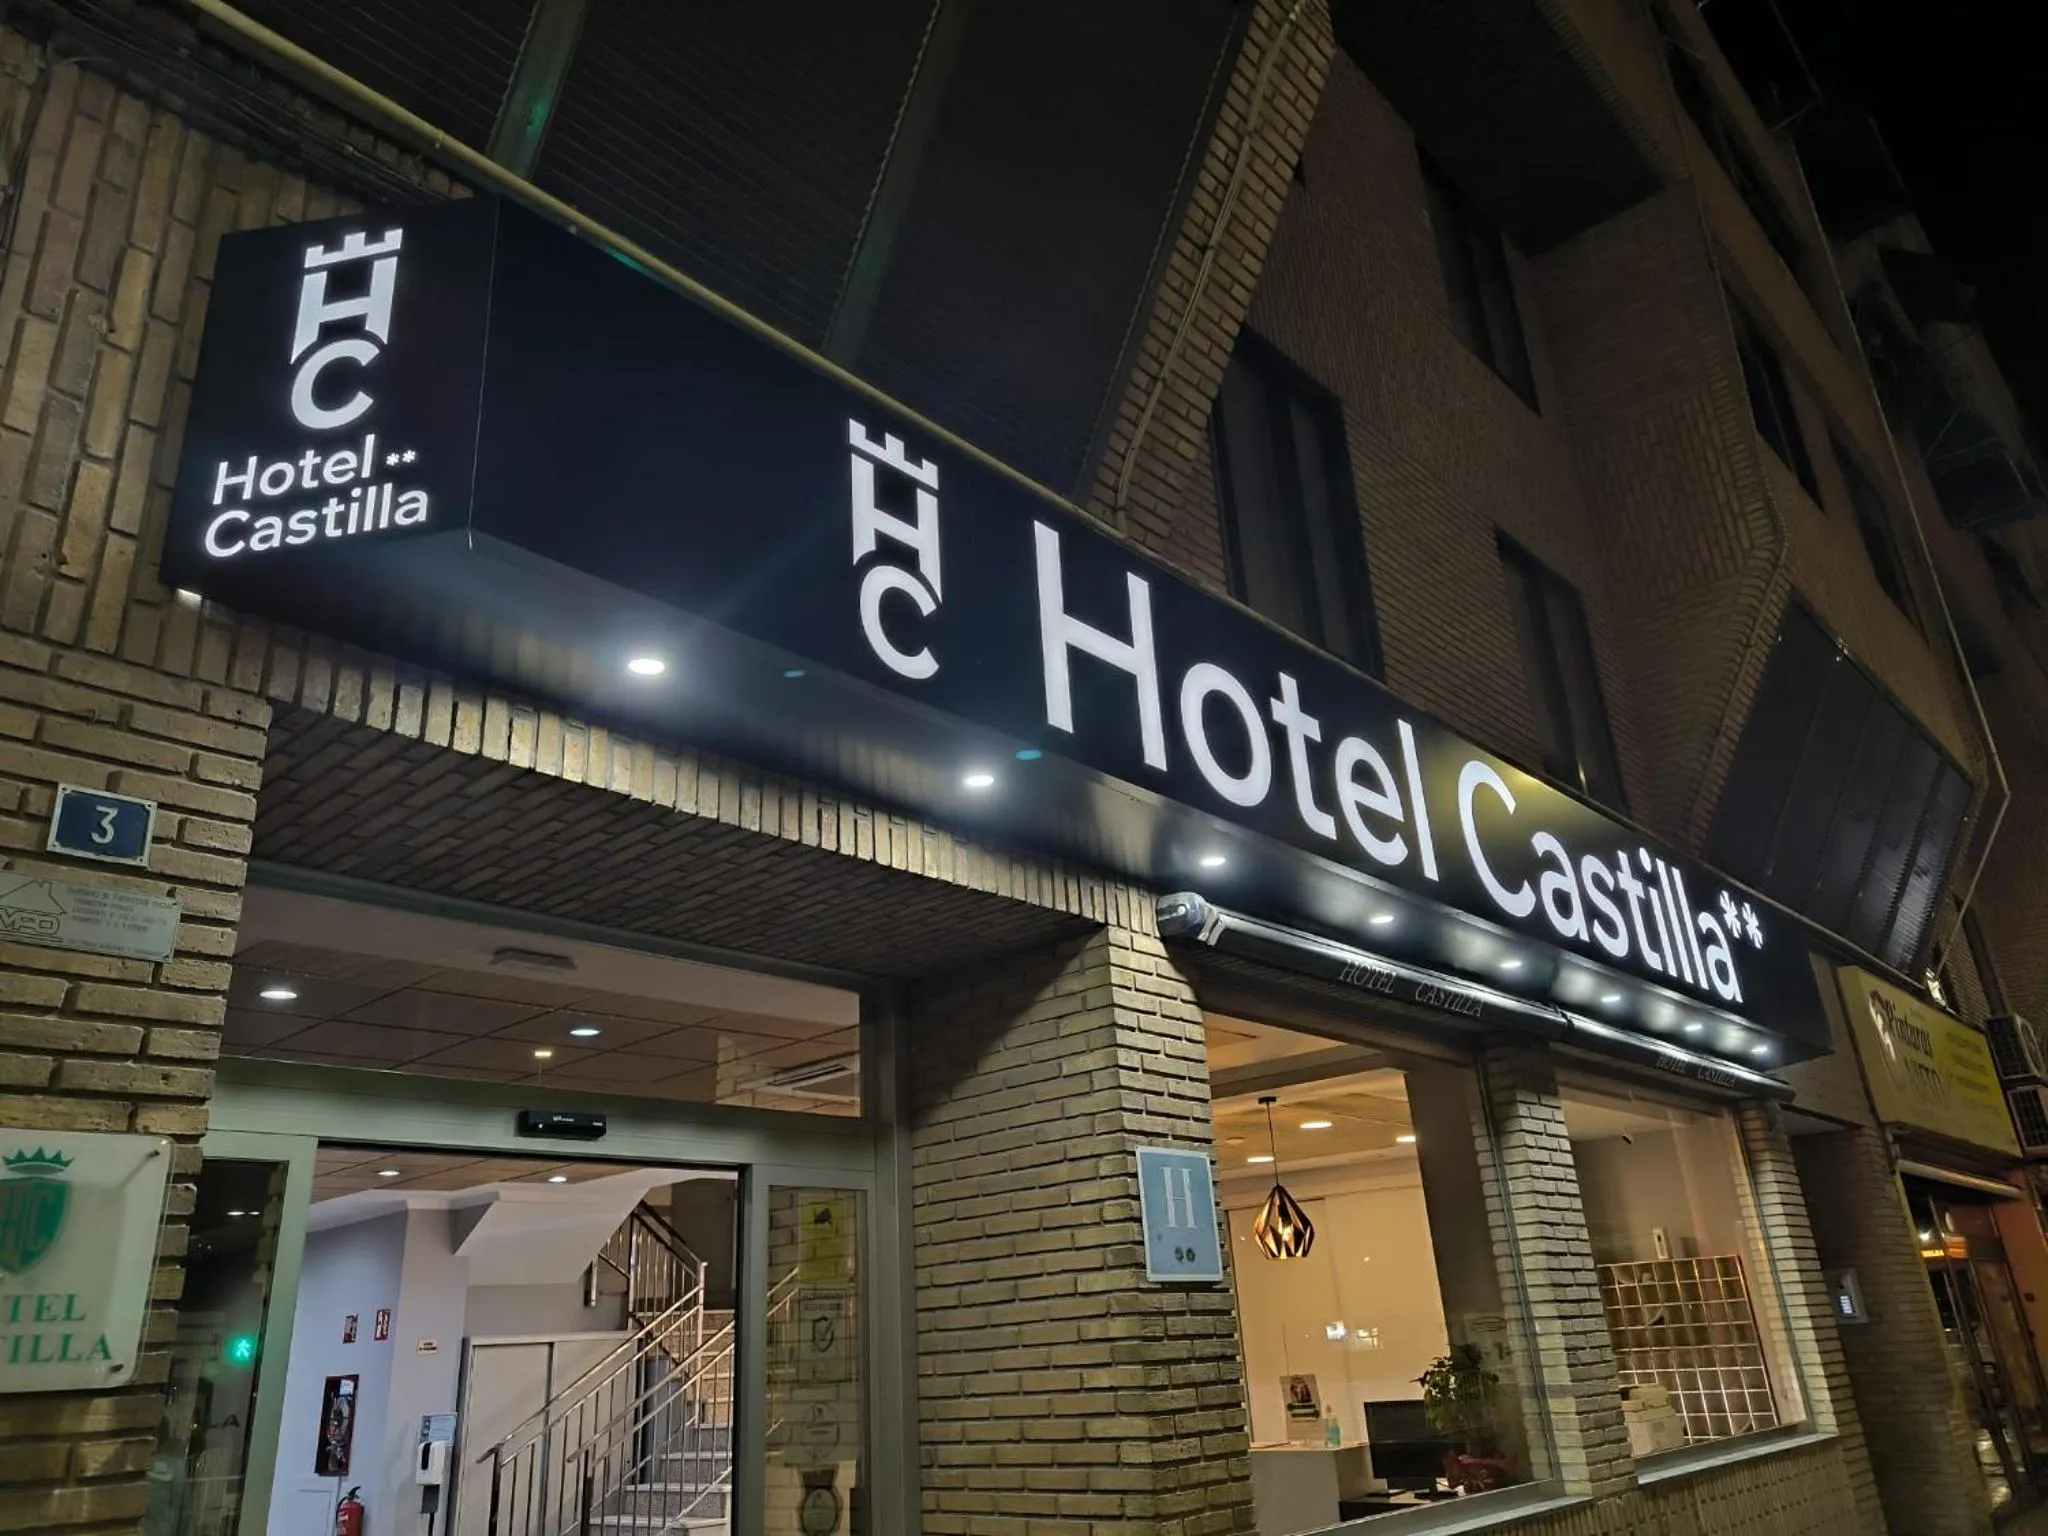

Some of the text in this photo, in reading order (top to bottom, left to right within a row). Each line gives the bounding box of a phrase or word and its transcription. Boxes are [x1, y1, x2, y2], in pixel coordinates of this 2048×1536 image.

[211, 433, 376, 506] Hotel
[204, 482, 429, 558] Castilla
[1033, 519, 1440, 882] Hotel
[90, 804, 119, 845] 3
[1339, 959, 1485, 1018] HOTEL CASTILLA
[1160, 1166, 1199, 1230] H
